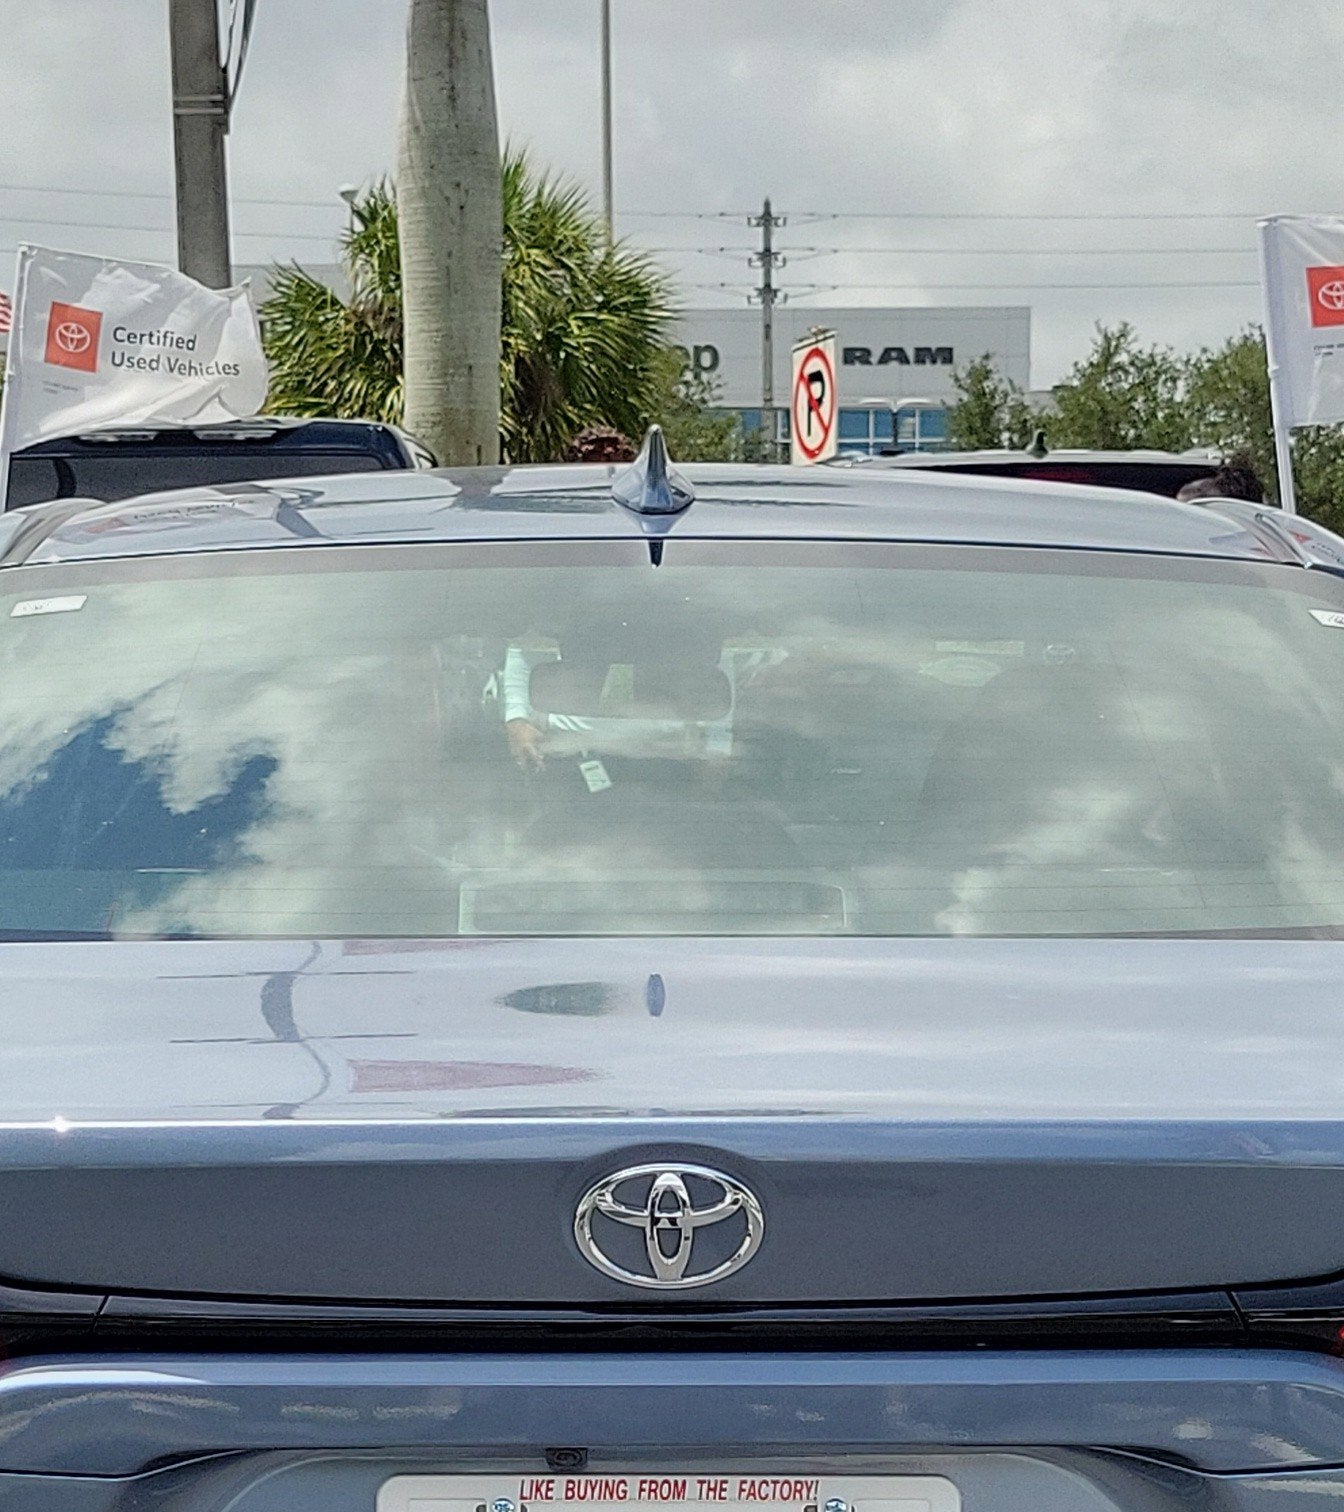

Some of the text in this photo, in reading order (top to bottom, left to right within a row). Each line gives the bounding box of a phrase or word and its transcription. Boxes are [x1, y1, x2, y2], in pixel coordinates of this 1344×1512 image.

[113, 326, 197, 351] Certified
[111, 352, 240, 377] Used Vehicles
[843, 347, 954, 366] RAM
[519, 1479, 820, 1501] LIKE BUYING FROM THE FACTORY!
